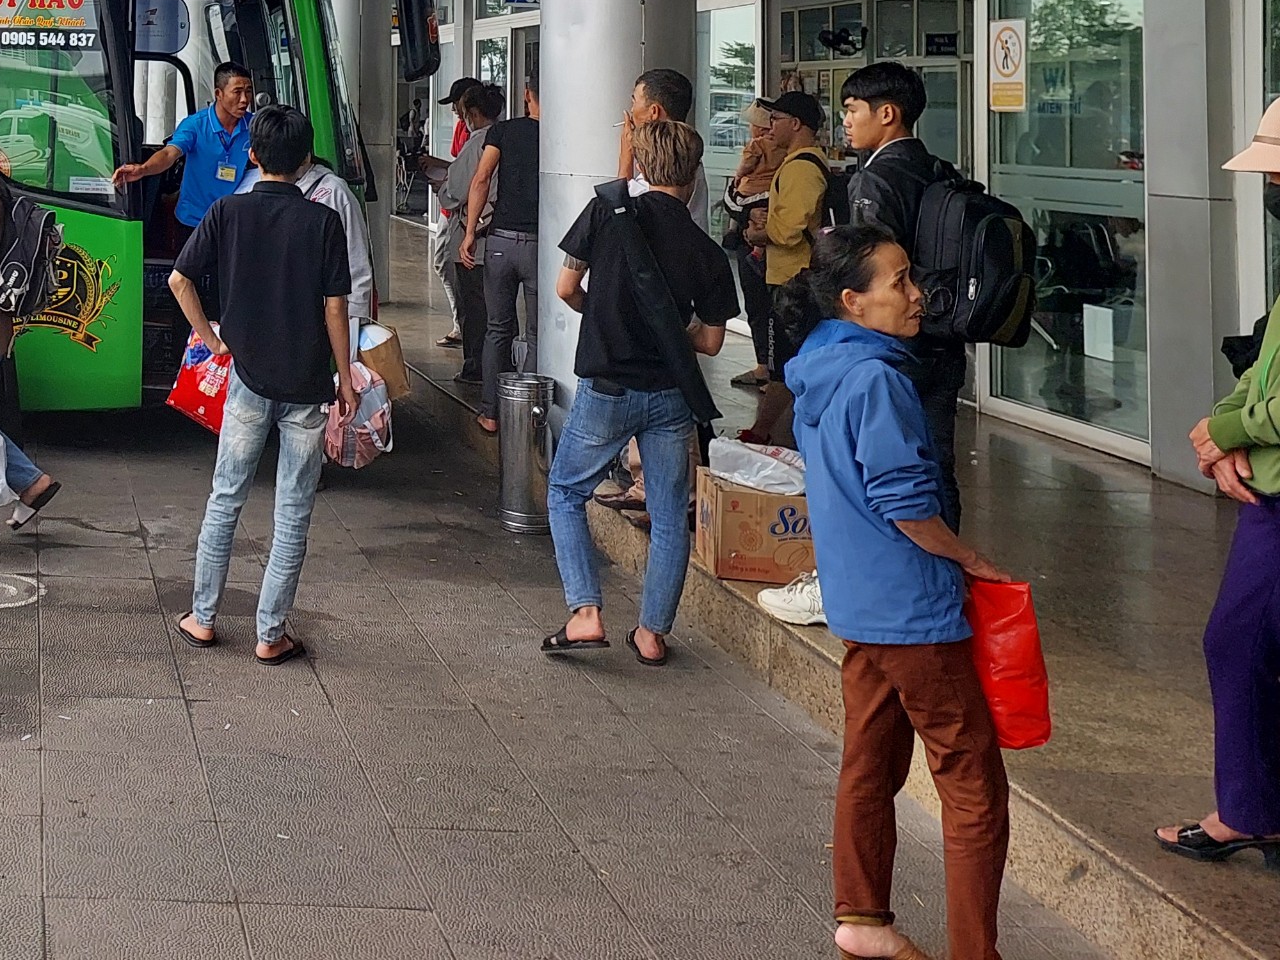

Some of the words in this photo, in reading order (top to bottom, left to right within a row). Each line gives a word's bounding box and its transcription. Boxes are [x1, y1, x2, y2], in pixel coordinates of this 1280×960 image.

[1, 31, 35, 46] 0905
[39, 32, 66, 46] 544
[69, 33, 95, 47] 837
[30, 313, 79, 329] LIMOUSINE
[770, 506, 812, 537] So
